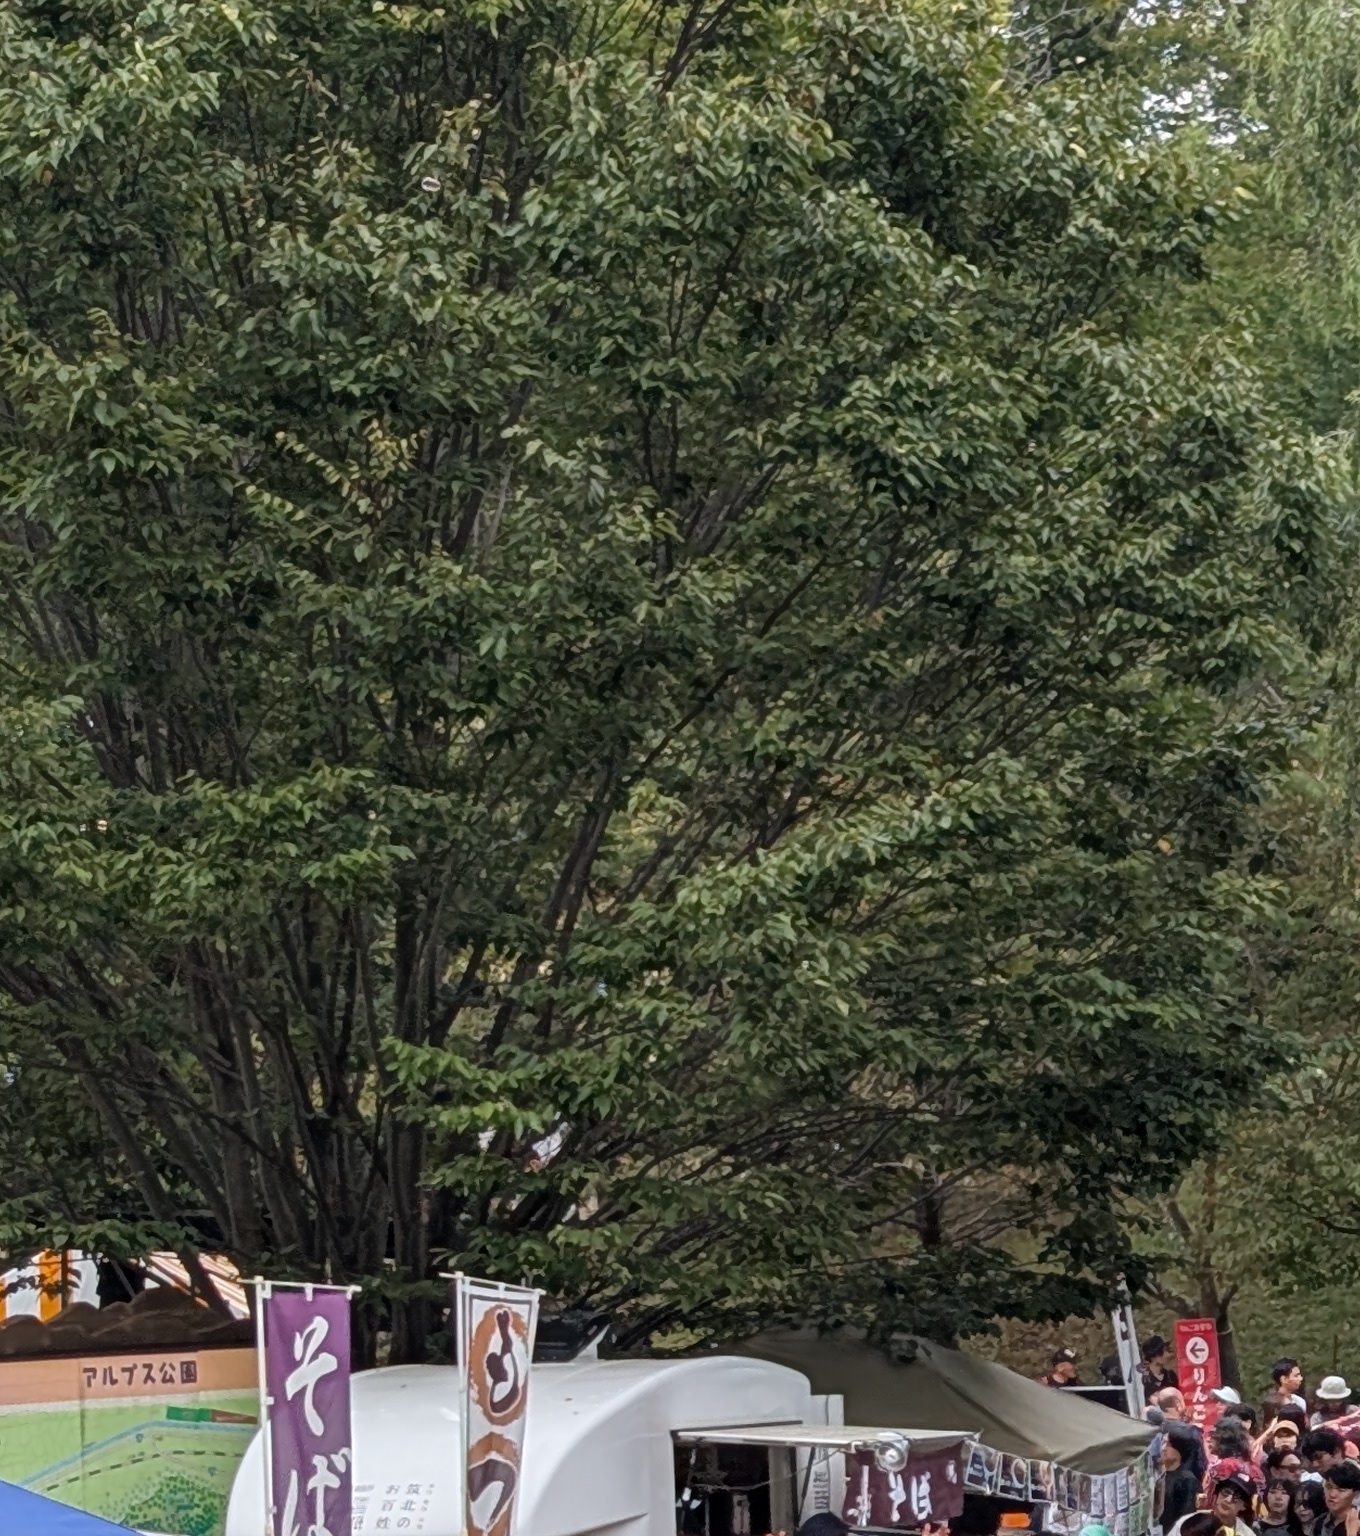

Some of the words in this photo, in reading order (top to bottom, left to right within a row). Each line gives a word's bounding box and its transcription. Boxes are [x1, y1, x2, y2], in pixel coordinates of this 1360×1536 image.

[82, 1359, 198, 1388] アルプス公園
